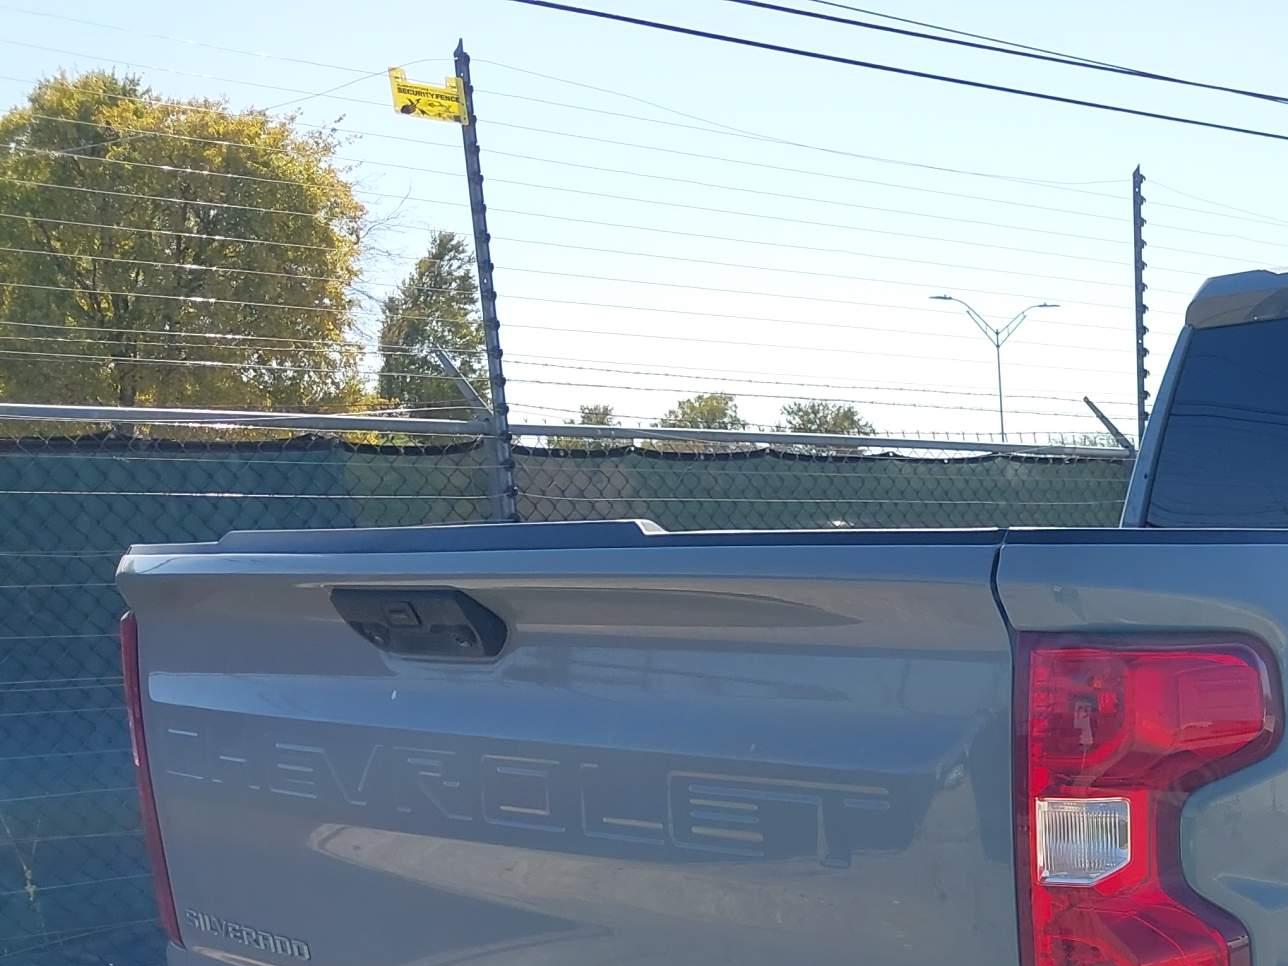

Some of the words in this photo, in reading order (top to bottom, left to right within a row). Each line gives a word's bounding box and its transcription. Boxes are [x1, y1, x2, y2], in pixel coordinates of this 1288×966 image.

[397, 87, 434, 99] SECURITY
[165, 727, 890, 868] CHEVROLET
[184, 908, 311, 960] SILVERADO
